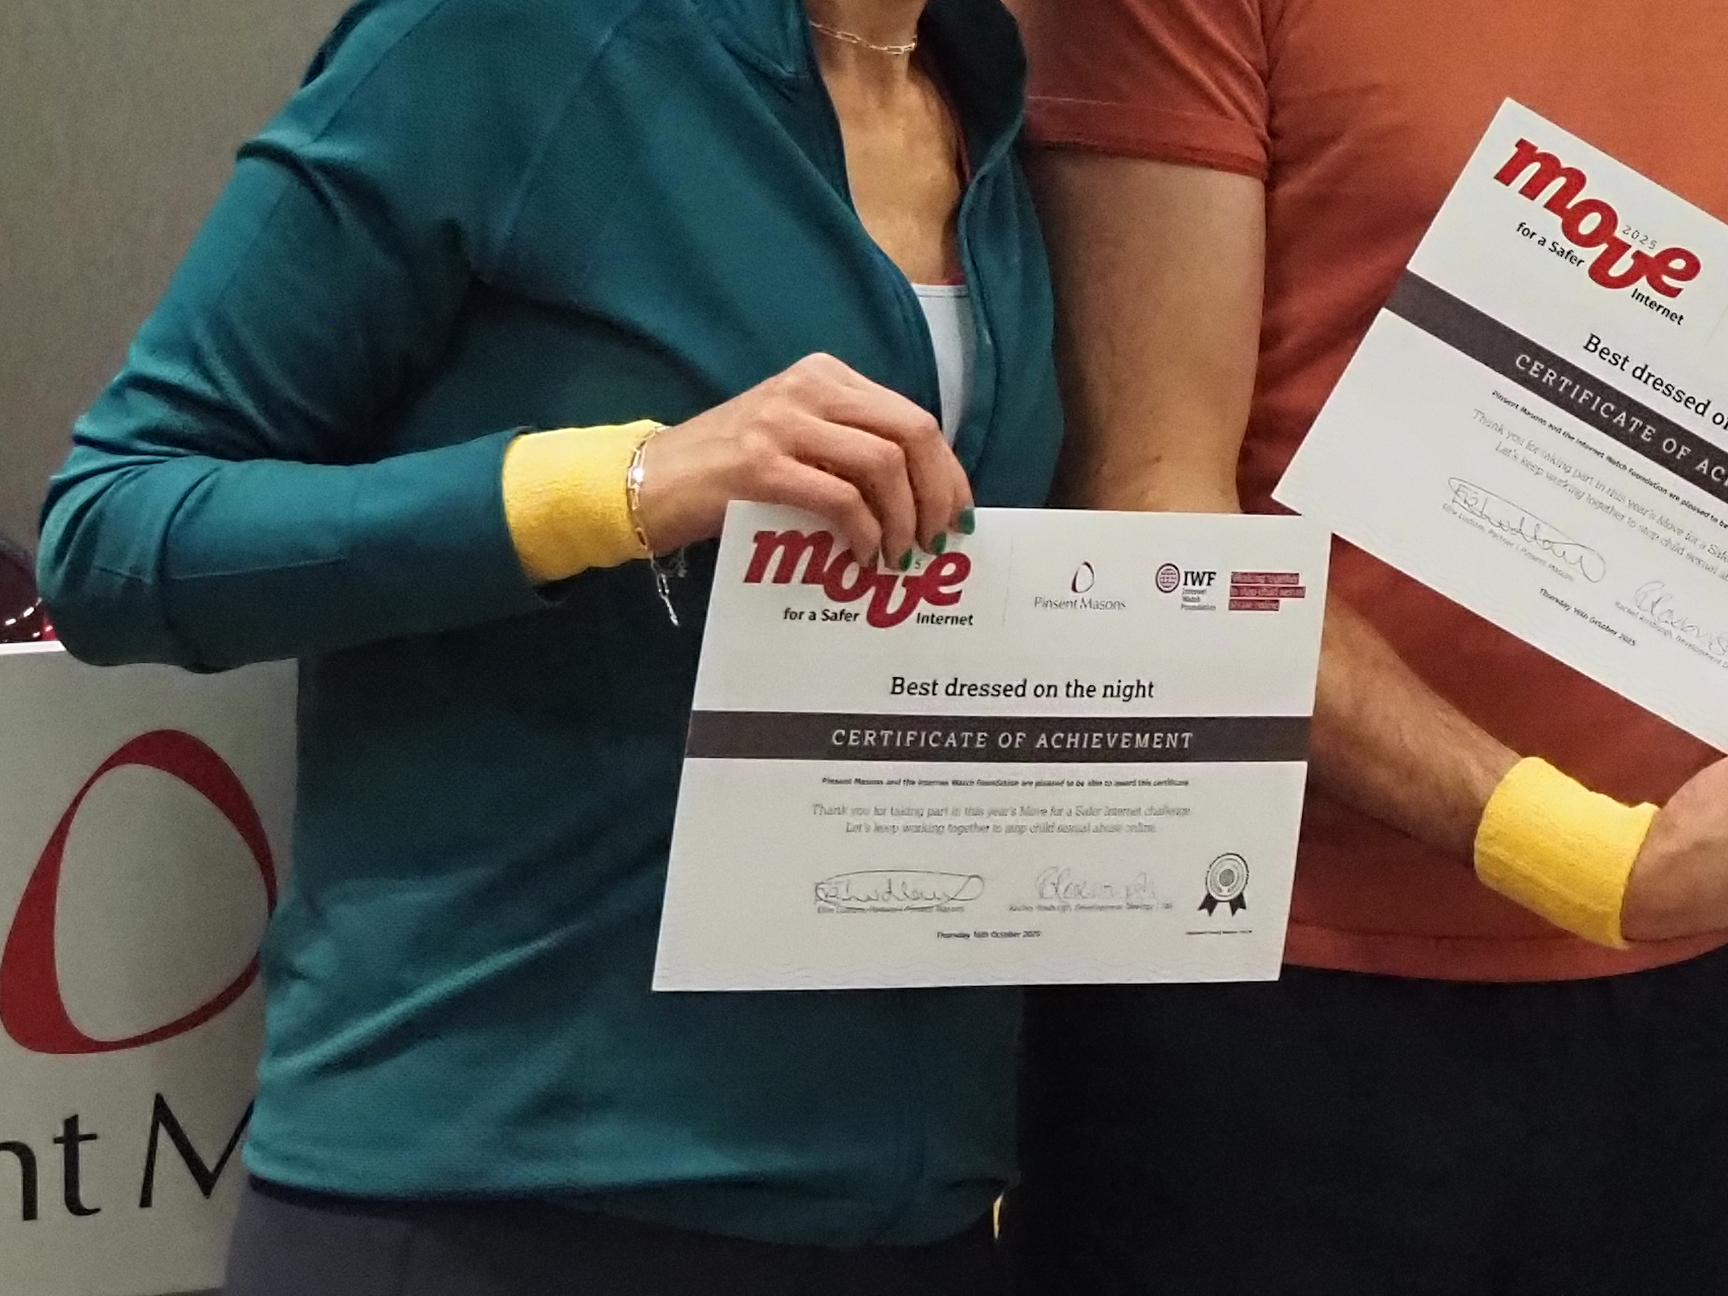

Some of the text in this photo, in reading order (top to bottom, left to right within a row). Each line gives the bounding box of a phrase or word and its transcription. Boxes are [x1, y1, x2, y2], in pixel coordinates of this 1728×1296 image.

[1493, 138, 1701, 298] move
[1621, 224, 1657, 250] 2025
[1515, 221, 1684, 325] for a Safer Internet
[1582, 333, 1629, 371] Best
[1631, 364, 1711, 416] dressed
[1515, 353, 1655, 441] CERTIFICATE
[1661, 437, 1691, 459] OF
[744, 529, 972, 629] move
[1182, 570, 1216, 586] IWF
[782, 606, 973, 626] for a Safer Internet
[1033, 596, 1126, 610] Pinsent Masons
[889, 675, 1154, 702] Best dressed on the night
[831, 728, 1192, 748] CERTIFICATE OF ACHIEVEMENT
